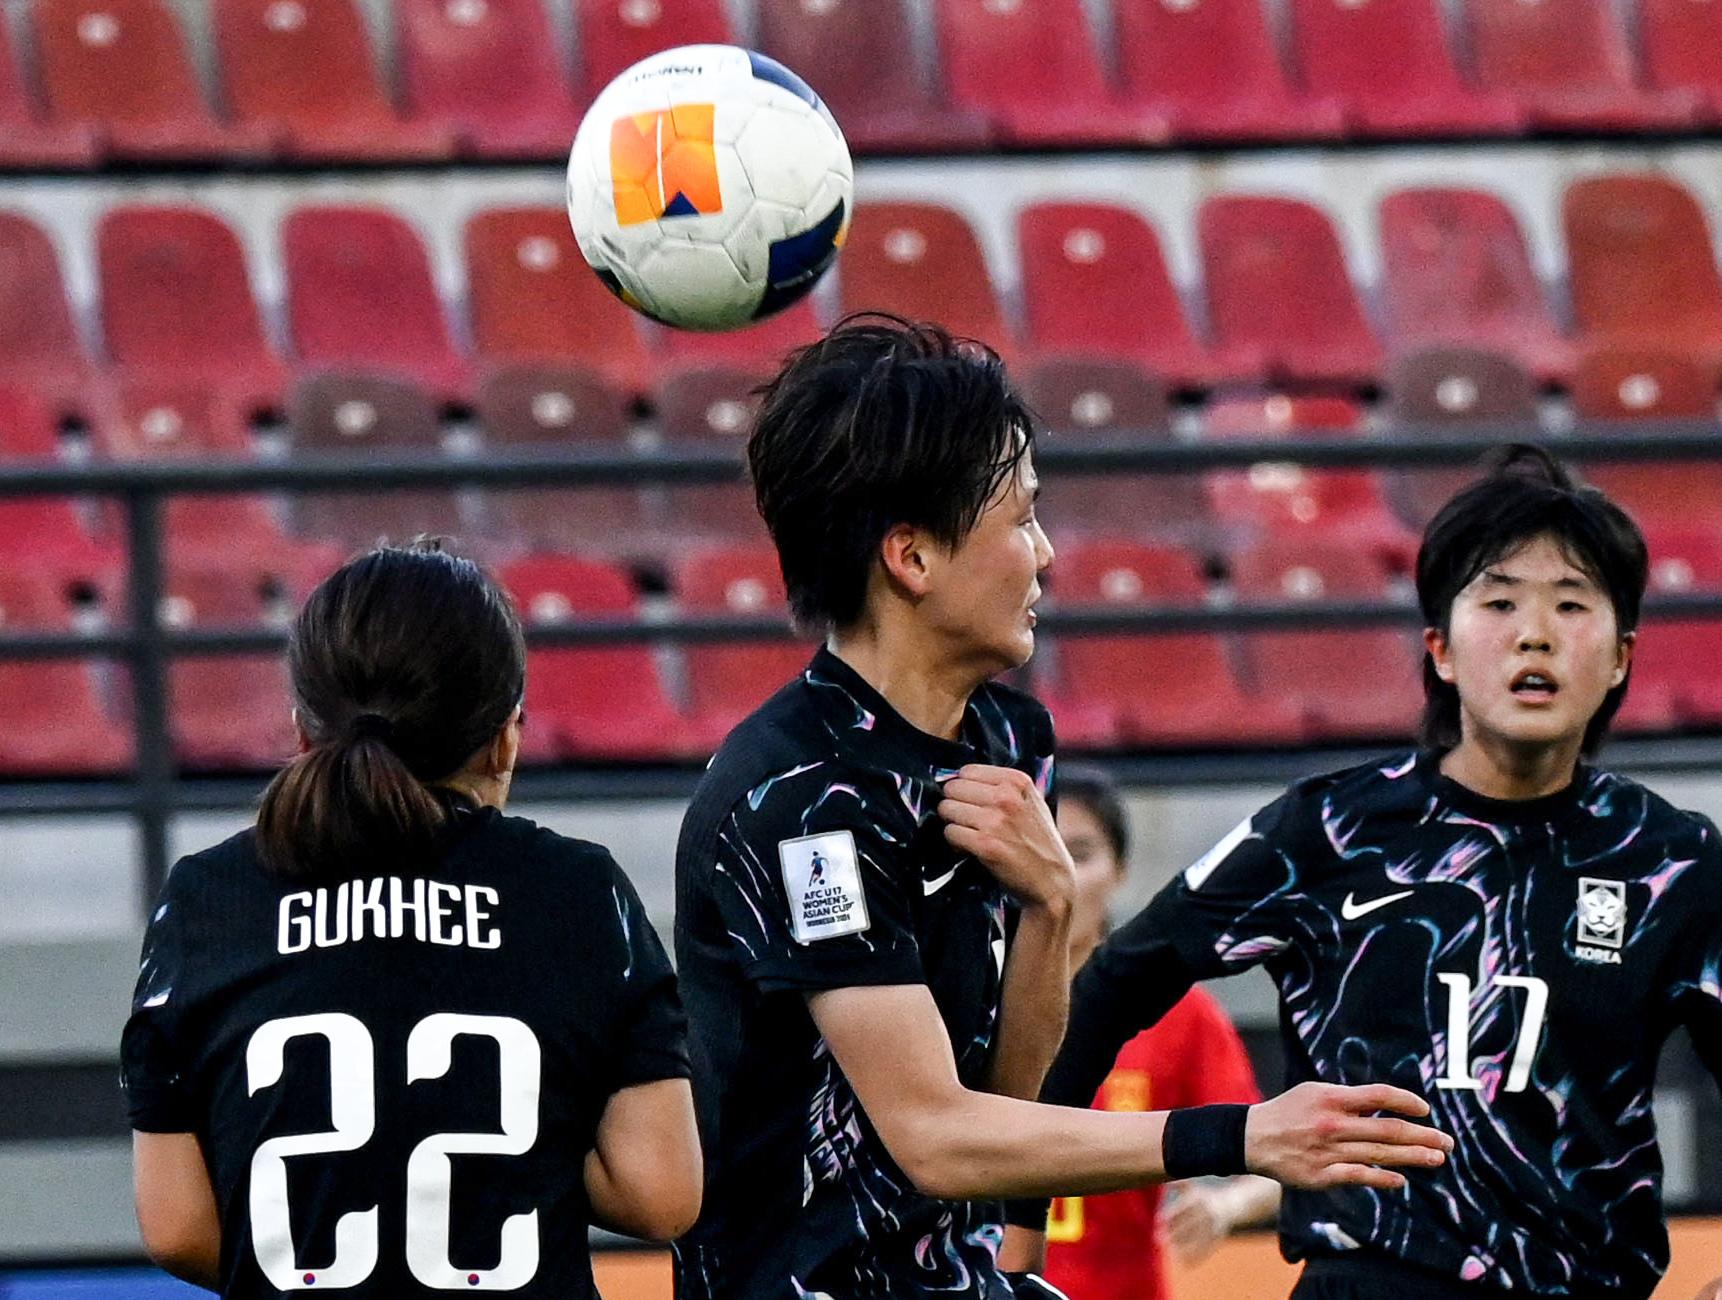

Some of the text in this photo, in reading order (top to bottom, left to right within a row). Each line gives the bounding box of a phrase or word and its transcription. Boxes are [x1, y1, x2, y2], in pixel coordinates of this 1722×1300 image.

[277, 876, 501, 955] GUKHEE
[802, 894, 849, 910] WOMEN'S
[803, 907, 831, 920] ASIAN
[804, 889, 823, 900] AFC
[1435, 972, 1549, 1093] 17
[246, 1012, 542, 1291] 22
